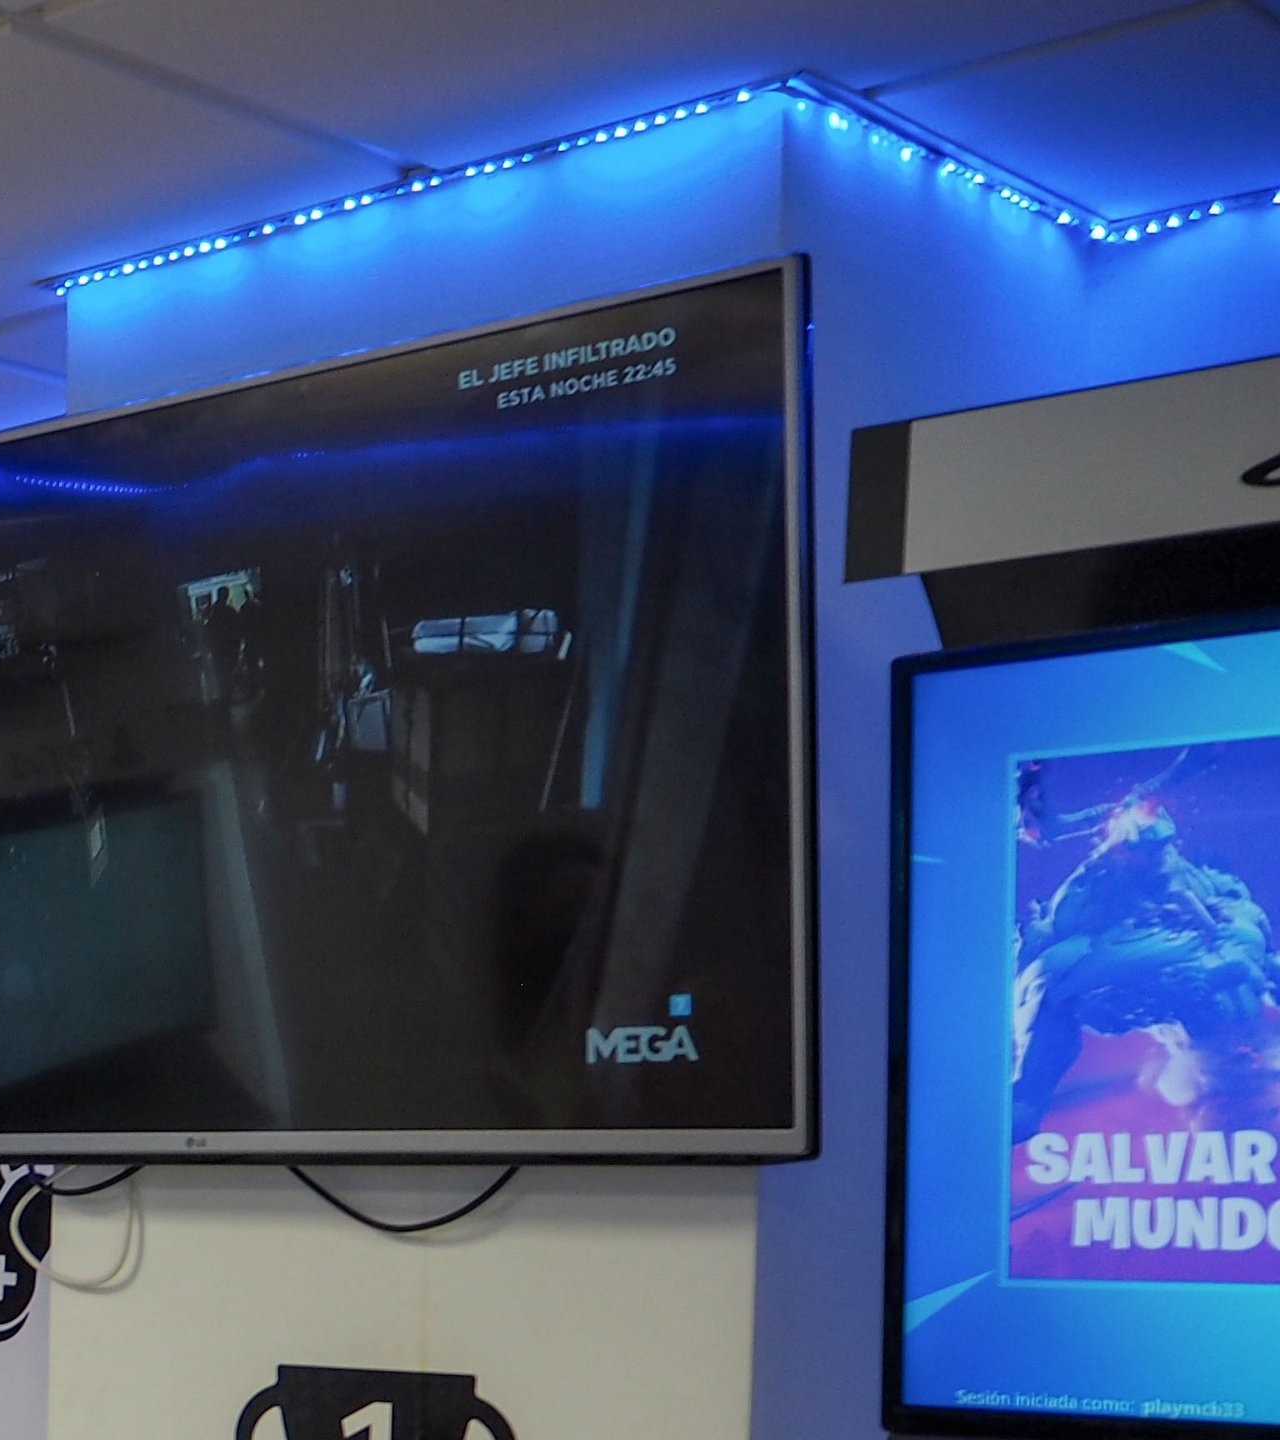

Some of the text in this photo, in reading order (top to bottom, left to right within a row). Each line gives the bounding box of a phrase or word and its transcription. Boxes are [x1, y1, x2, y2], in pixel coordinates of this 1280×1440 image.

[458, 327, 677, 390] EL JEFE INFILTRADO
[496, 357, 677, 410] ESTA NOCHE 22:45
[585, 1025, 699, 1064] MEGA
[1027, 1130, 1277, 1184] SALVAR
[1072, 1196, 1280, 1251] MUND
[955, 1389, 1011, 1406] Sesión
[1015, 1391, 1078, 1409] iniciada
[1081, 1397, 1135, 1412] como:
